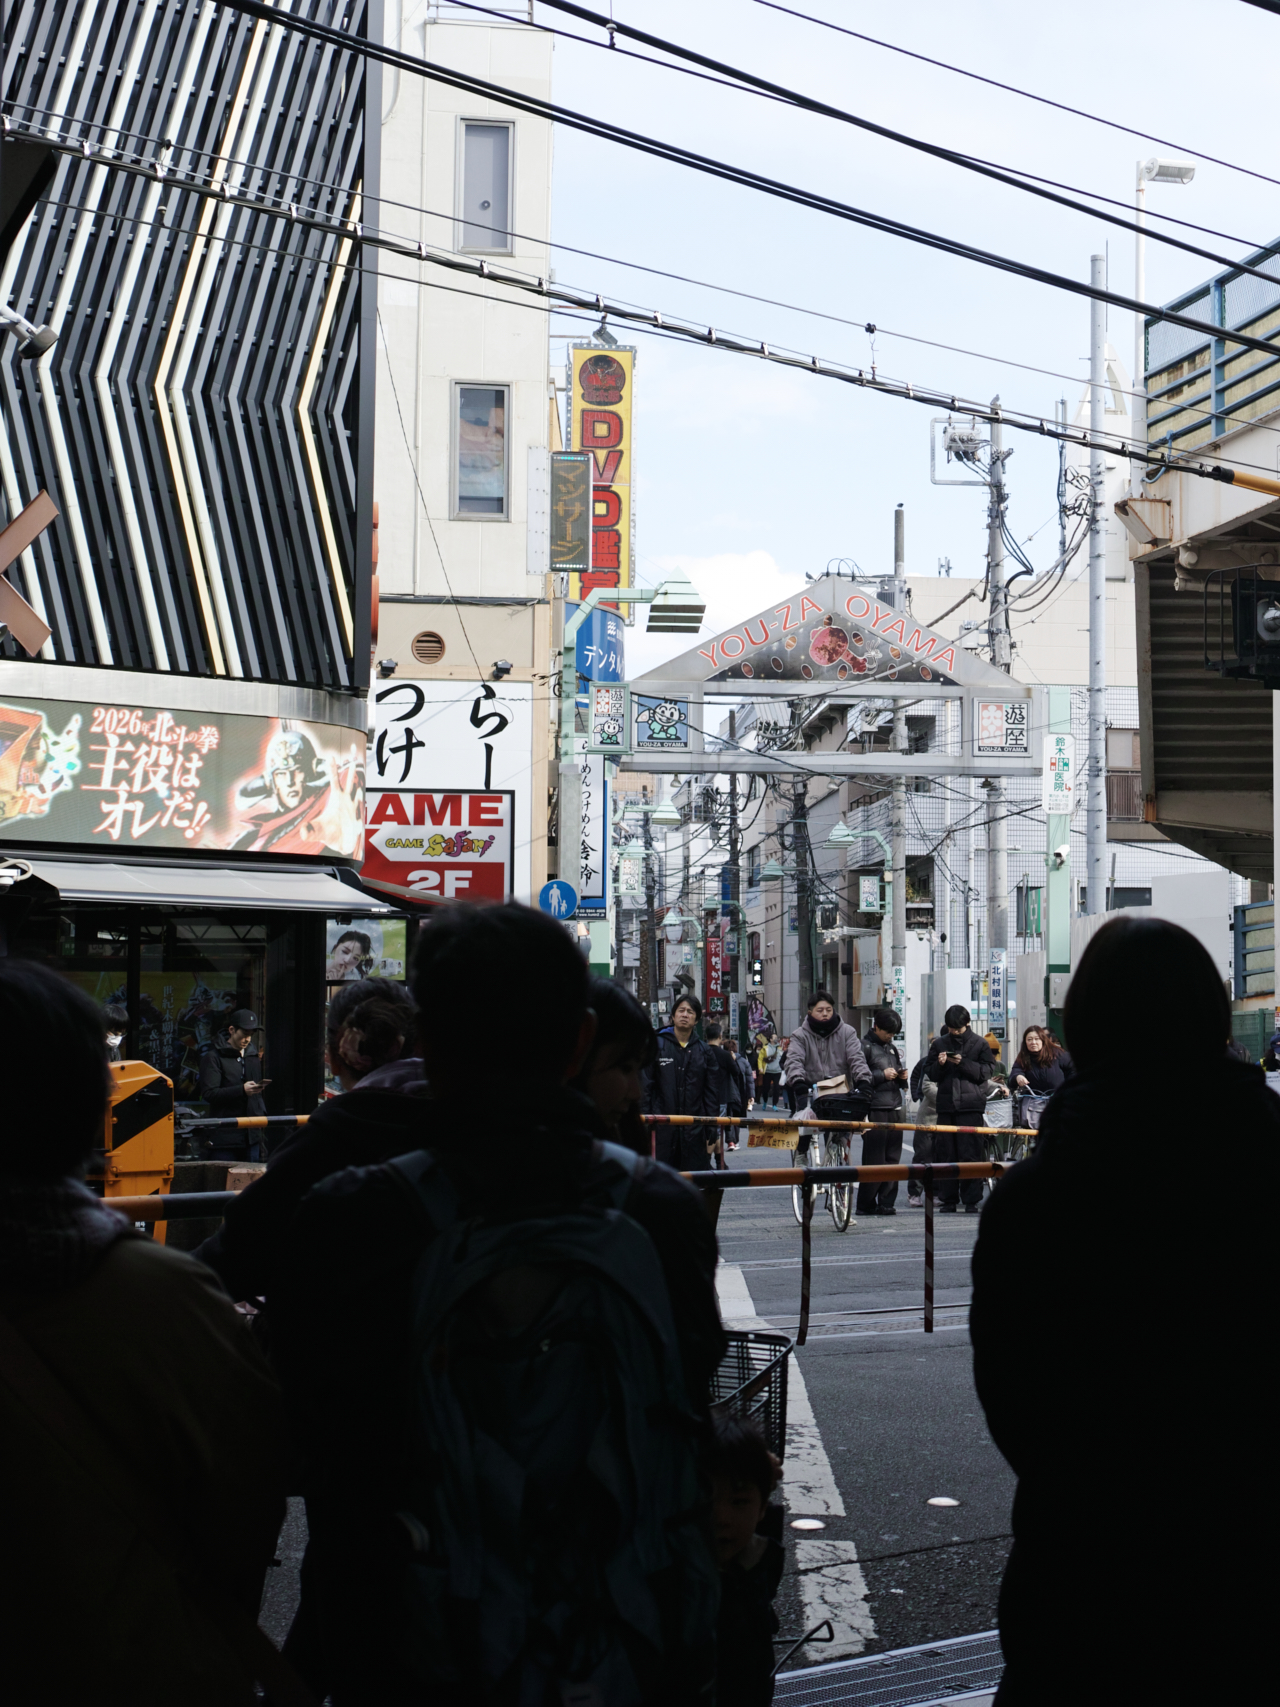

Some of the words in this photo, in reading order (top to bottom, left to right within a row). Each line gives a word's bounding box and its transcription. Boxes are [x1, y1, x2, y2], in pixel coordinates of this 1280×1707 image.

[551, 462, 587, 563] マッサージ
[698, 594, 824, 669] YOU-ZA
[844, 594, 957, 673] OYAMA
[1005, 704, 1025, 746] 遊座
[1055, 737, 1065, 756] 鈴木
[81, 733, 203, 799] 主役は
[1054, 772, 1065, 792] 医院
[365, 794, 503, 826] AME
[385, 838, 424, 849] GAME
[422, 830, 496, 858] Safari
[406, 869, 473, 899] 2F
[992, 966, 1001, 1009] 北村眼科
